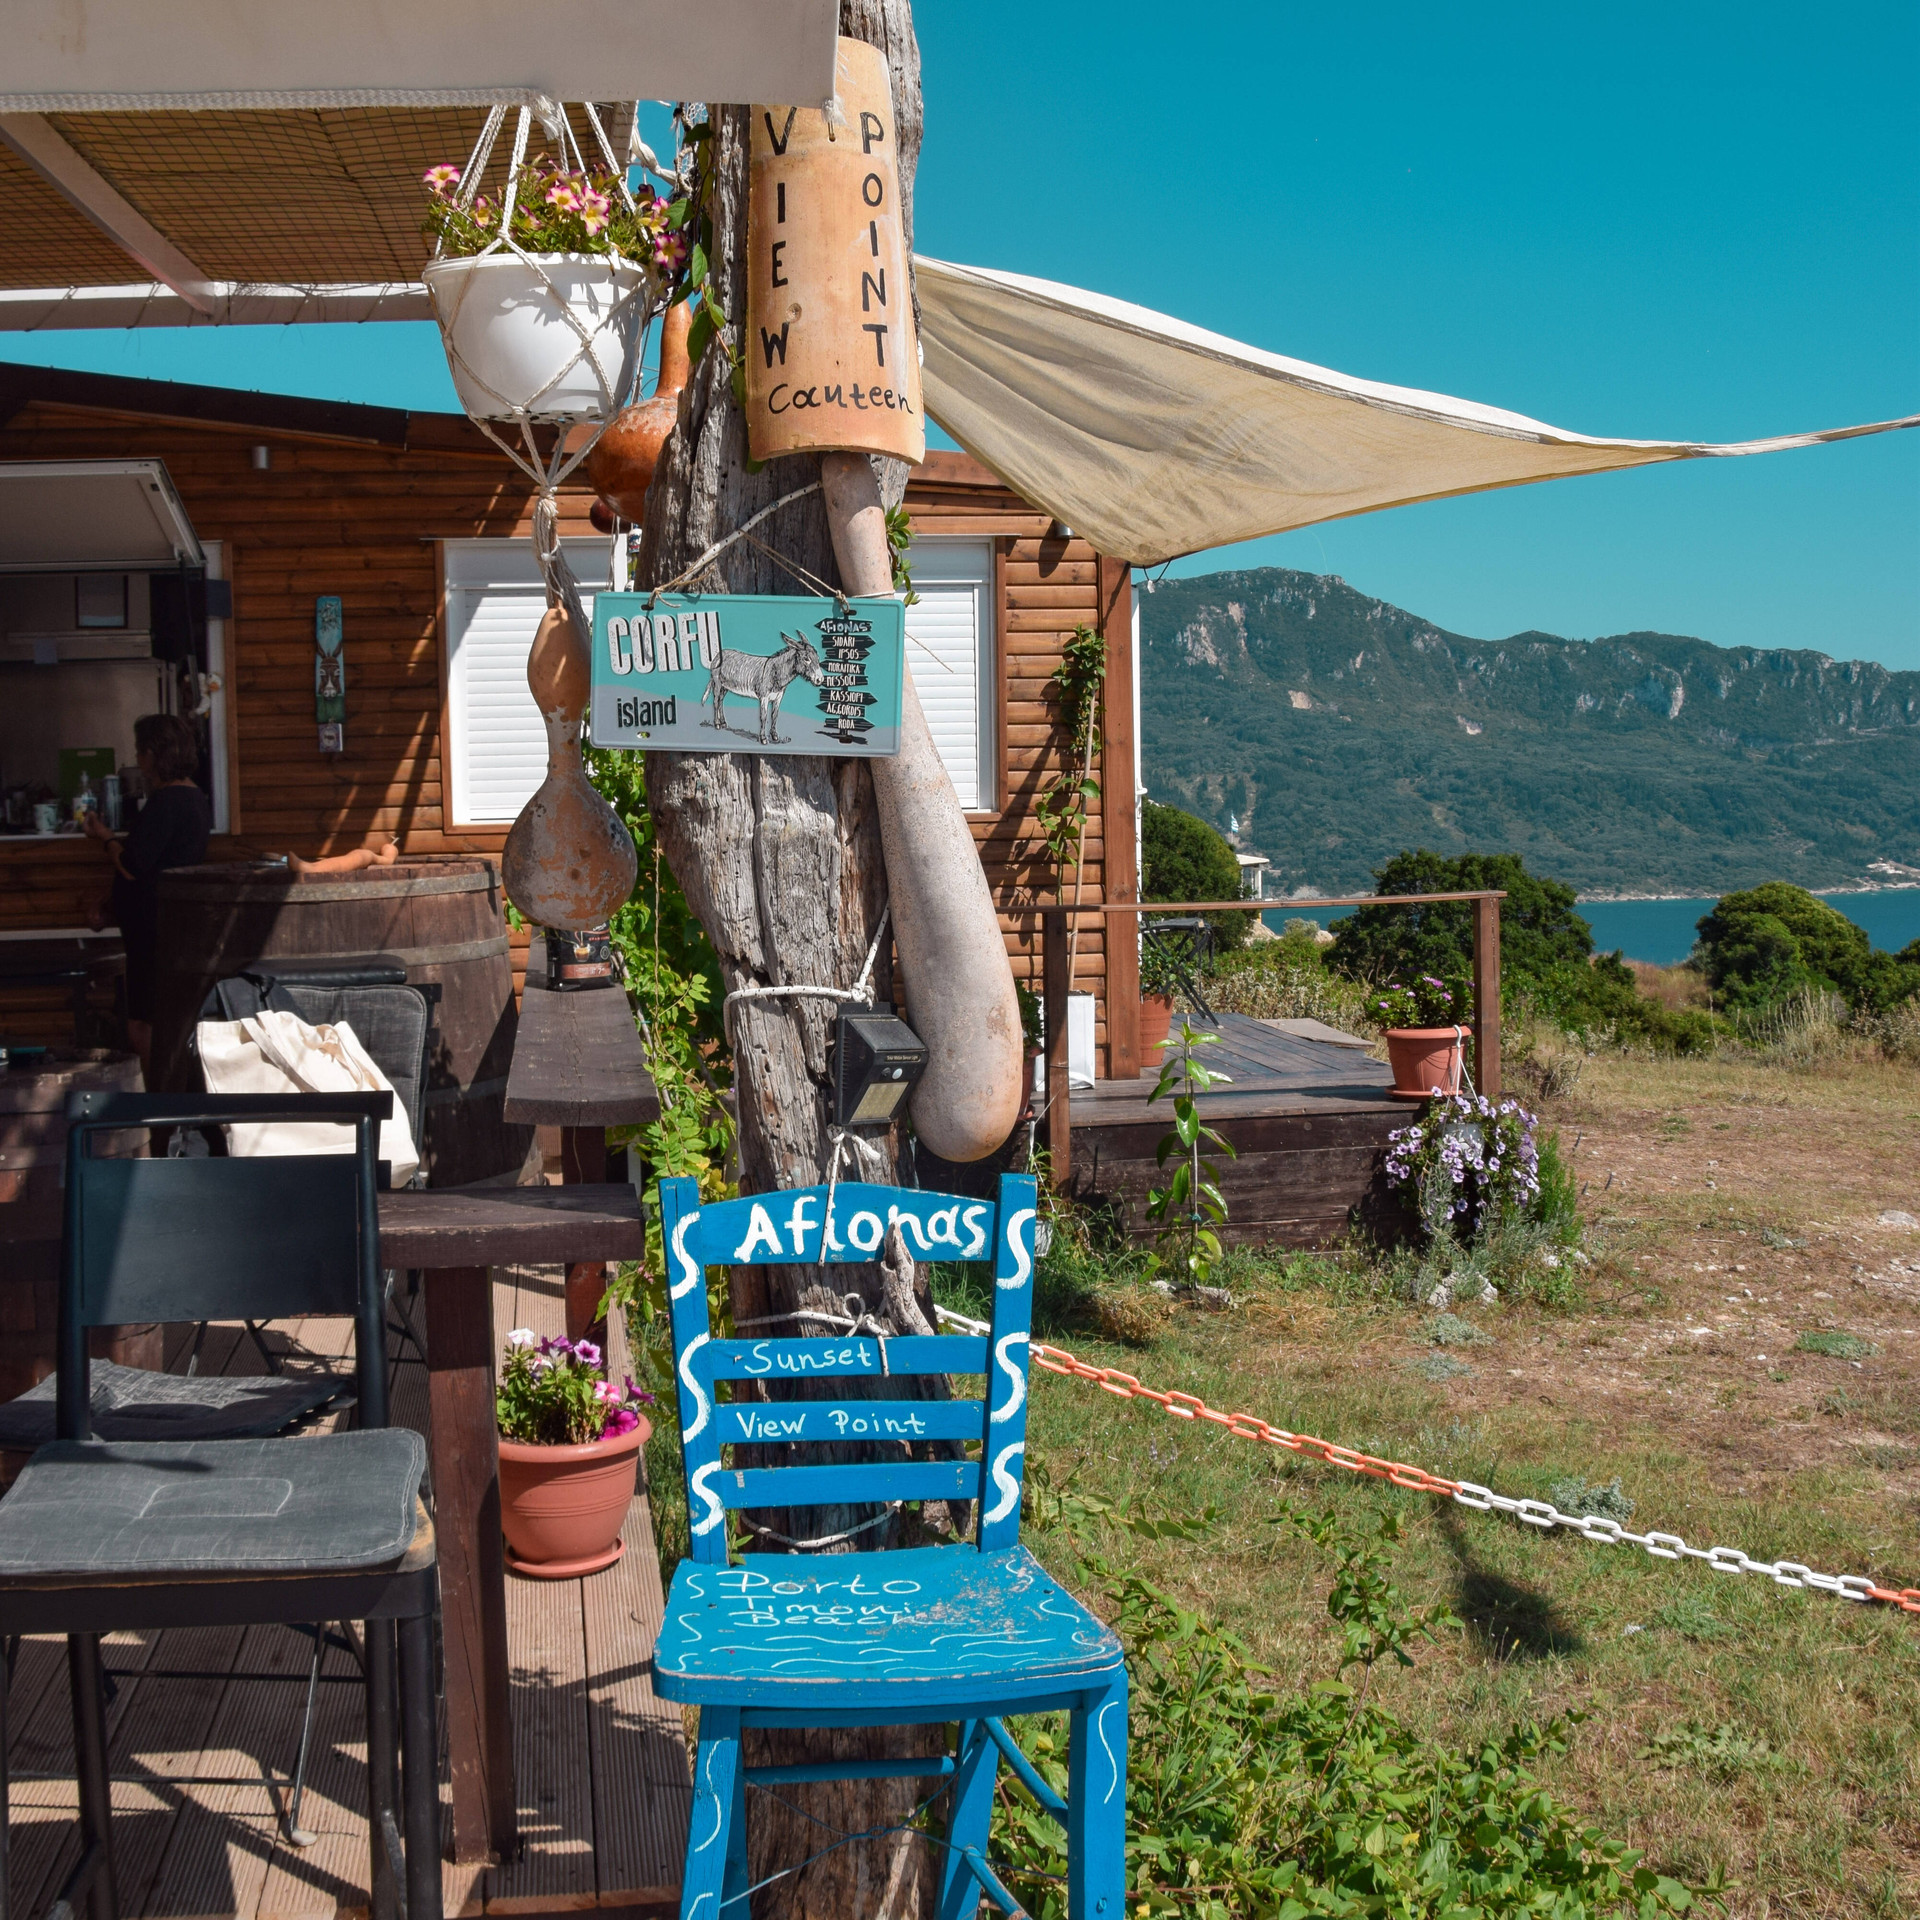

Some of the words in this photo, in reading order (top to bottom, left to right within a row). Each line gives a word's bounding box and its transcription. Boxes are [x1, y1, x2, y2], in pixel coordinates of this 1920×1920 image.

[761, 106, 798, 368] VIEW
[860, 112, 888, 367] POINT
[820, 620, 868, 634] AFIONAS
[832, 636, 856, 647] SIDARI
[607, 611, 723, 675] CORFU
[838, 648, 860, 660] IPSOS
[617, 694, 677, 728] island
[830, 690, 864, 703] KASSIOPI
[837, 718, 856, 729] RODA
[734, 1196, 988, 1263] Afionas
[744, 1343, 872, 1374] Sunset
[735, 1411, 806, 1438] View
[829, 1409, 926, 1435] Point
[715, 1570, 922, 1596] Porto
